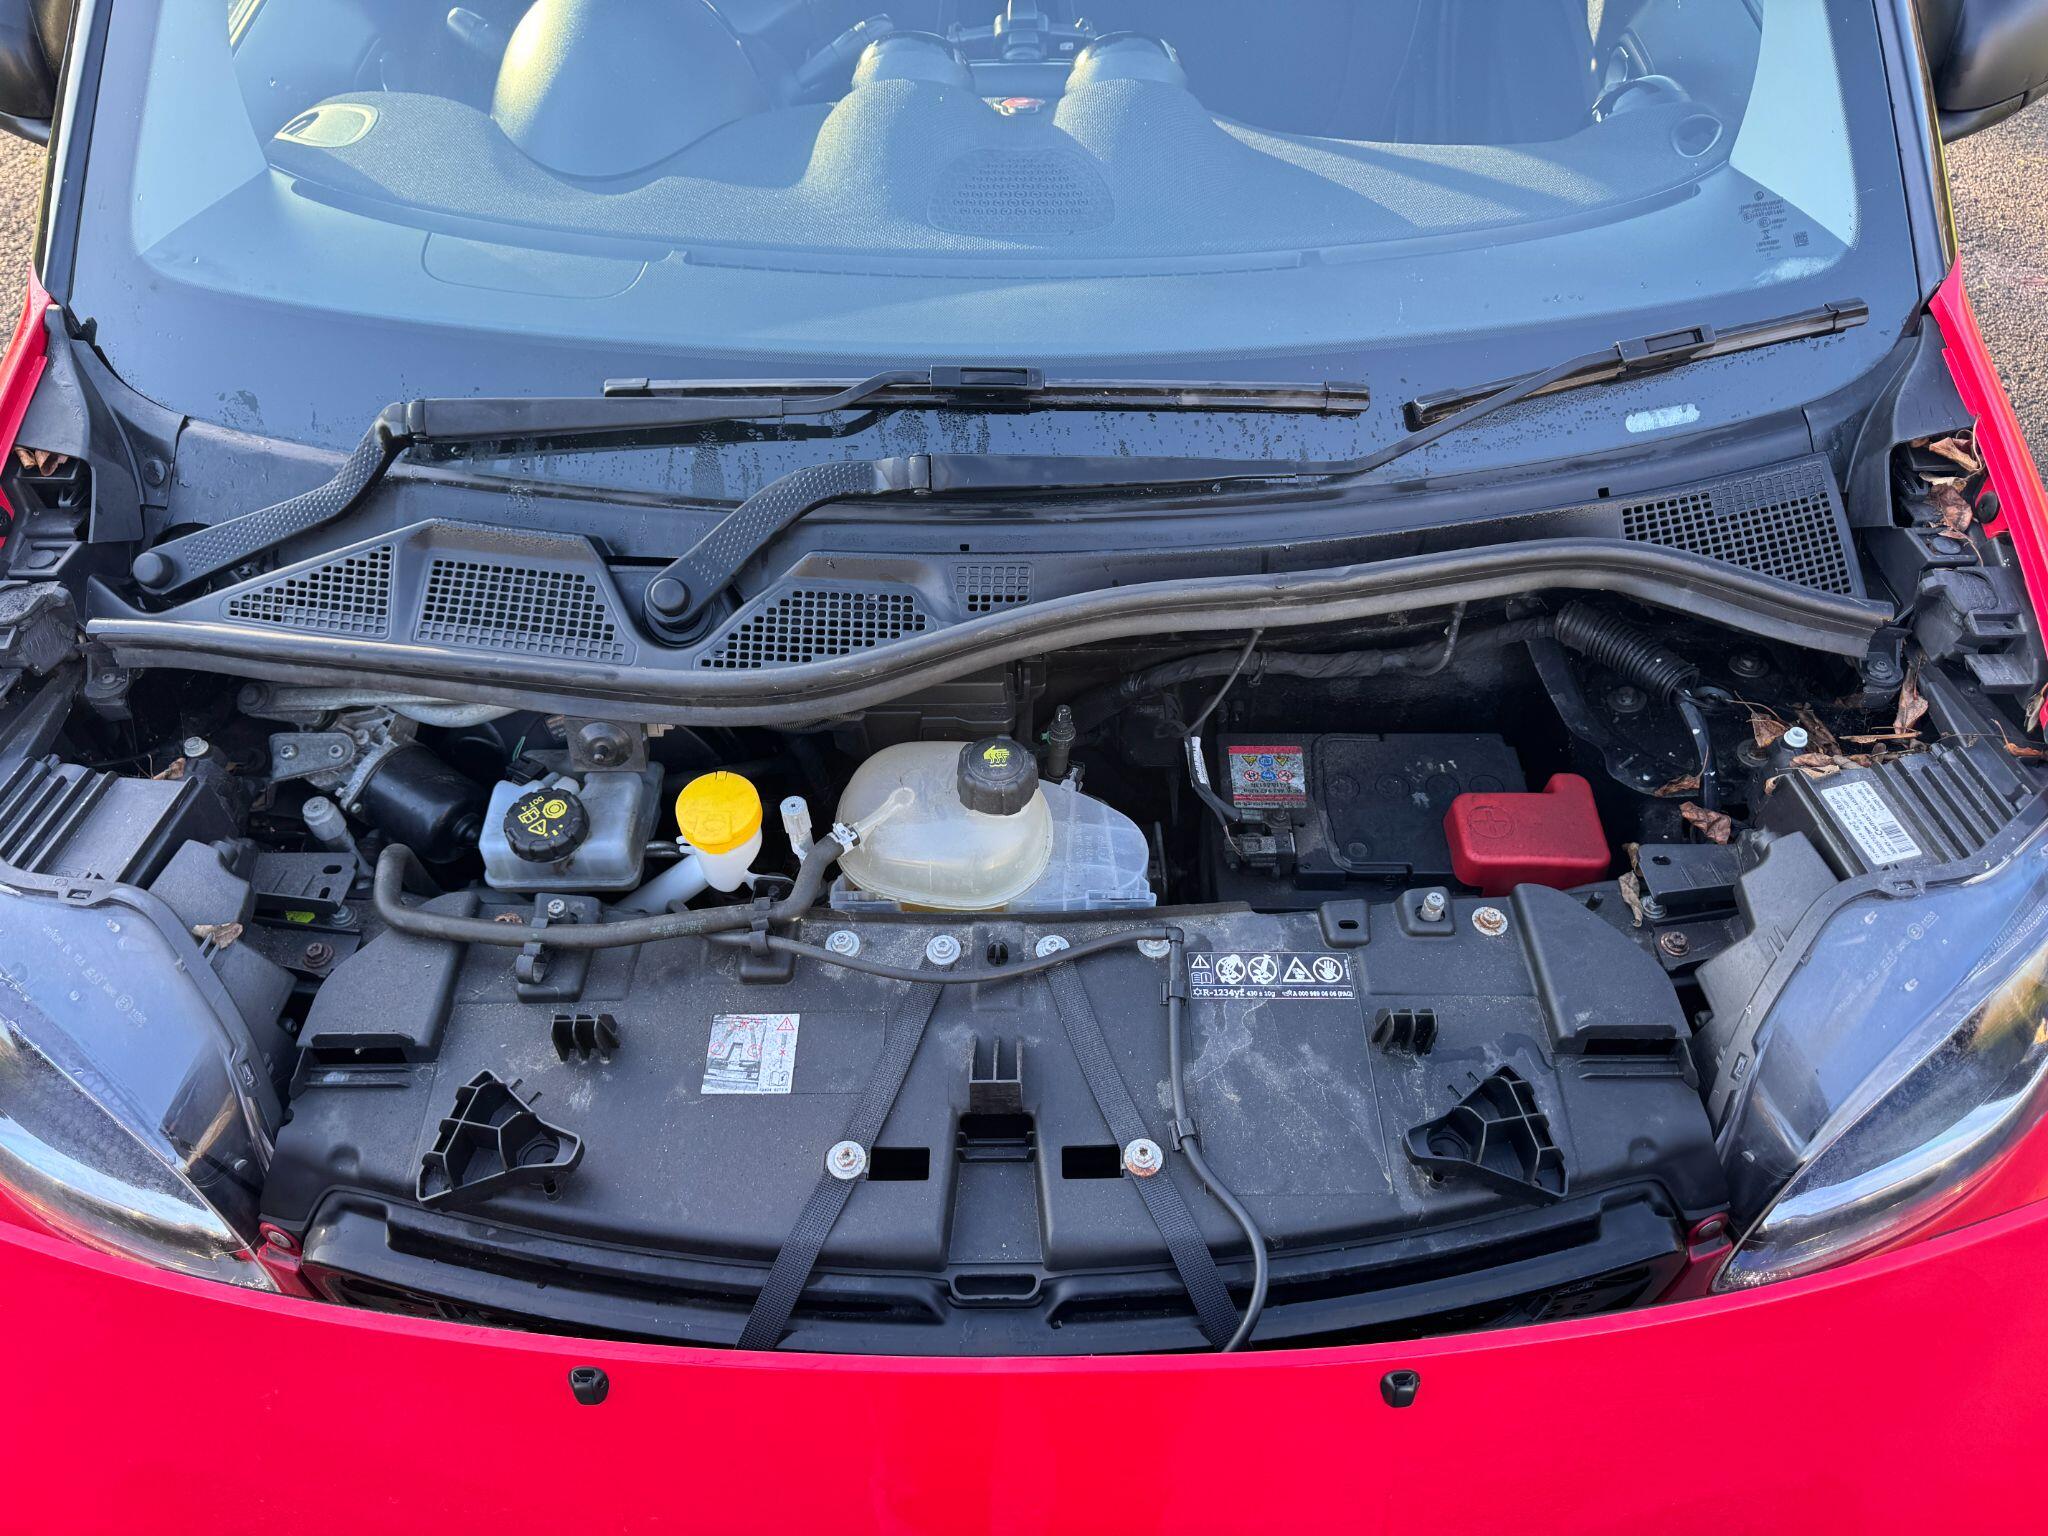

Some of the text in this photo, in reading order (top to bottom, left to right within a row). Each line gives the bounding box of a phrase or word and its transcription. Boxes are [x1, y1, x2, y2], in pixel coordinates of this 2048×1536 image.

[529, 795, 545, 808] DOT
[1202, 988, 1245, 999] R-1234yf
[1263, 990, 1276, 998] 10g
